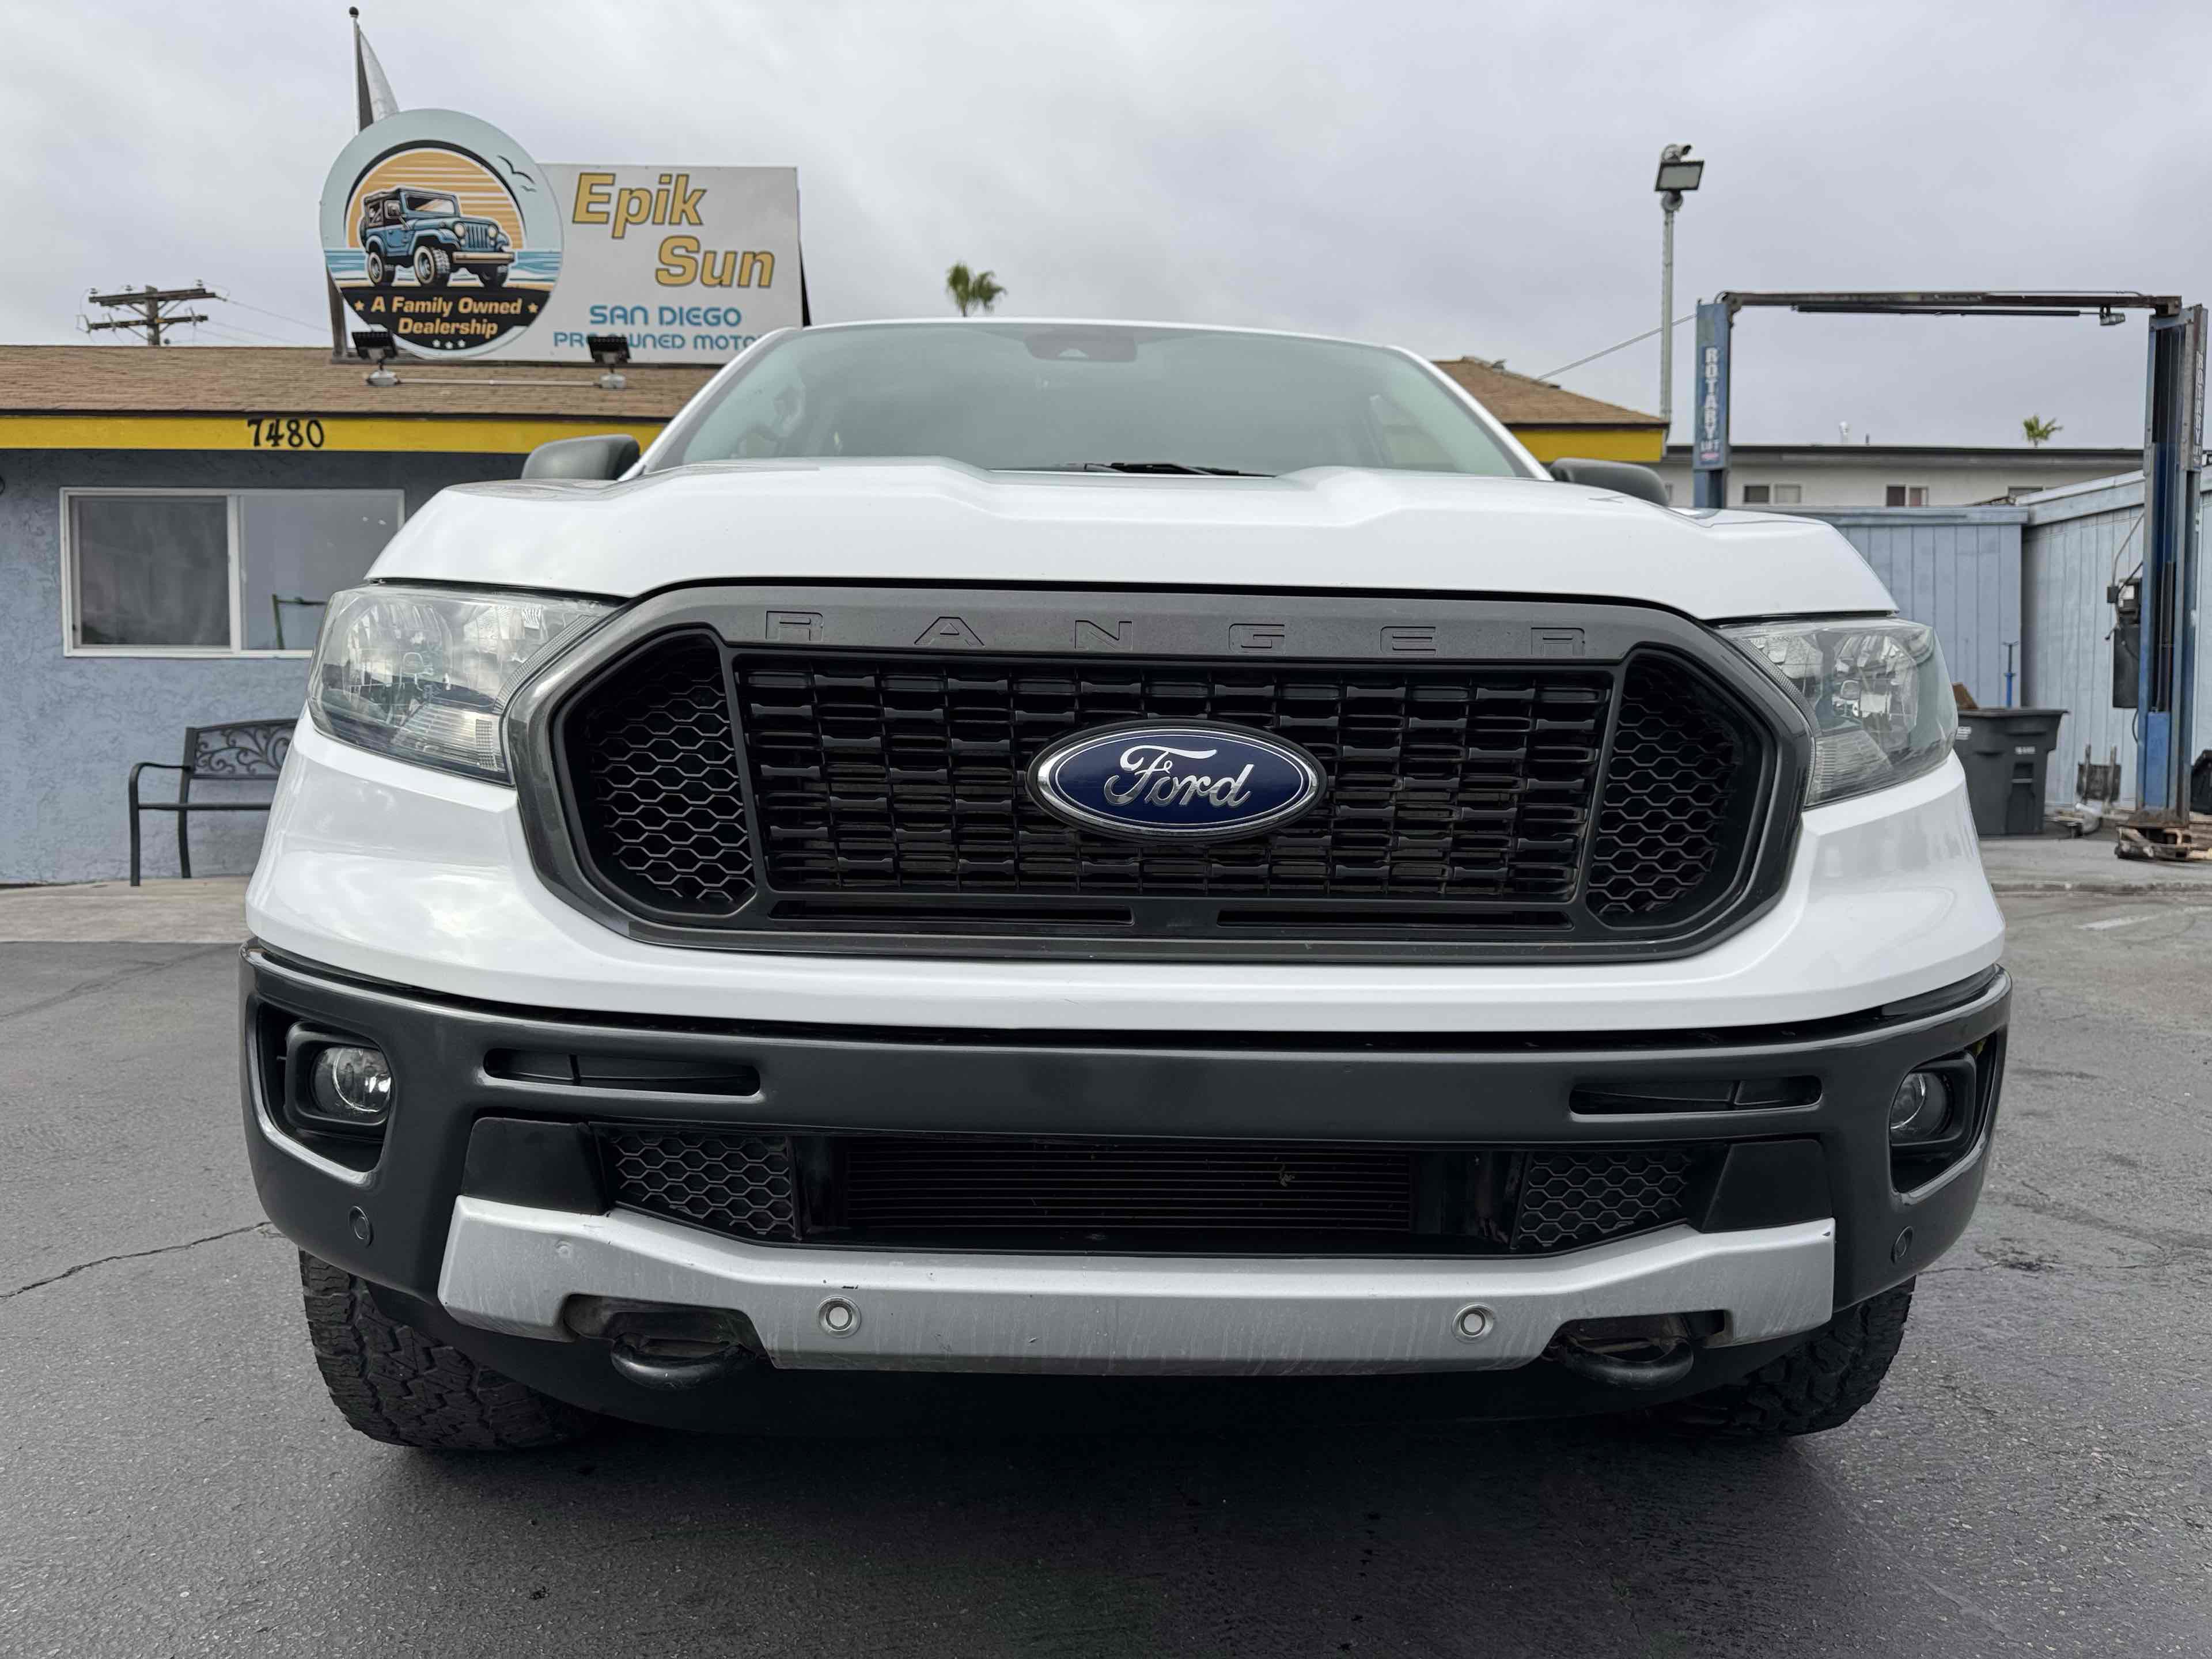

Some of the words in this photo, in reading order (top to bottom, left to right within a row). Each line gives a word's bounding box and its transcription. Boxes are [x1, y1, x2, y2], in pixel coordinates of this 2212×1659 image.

[572, 173, 707, 239] Epik
[655, 235, 775, 289] Sun
[370, 297, 386, 313] A
[391, 297, 453, 317] Family
[458, 297, 522, 314] Owned
[589, 305, 649, 325] SAN
[658, 306, 742, 327] DIEGO
[397, 317, 498, 339] Dealership
[694, 335, 763, 350] MOTO
[1705, 347, 1718, 440] ROTARY
[247, 419, 324, 448] 7480
[766, 610, 1585, 656] RANGER
[1104, 745, 1255, 807] Ford
